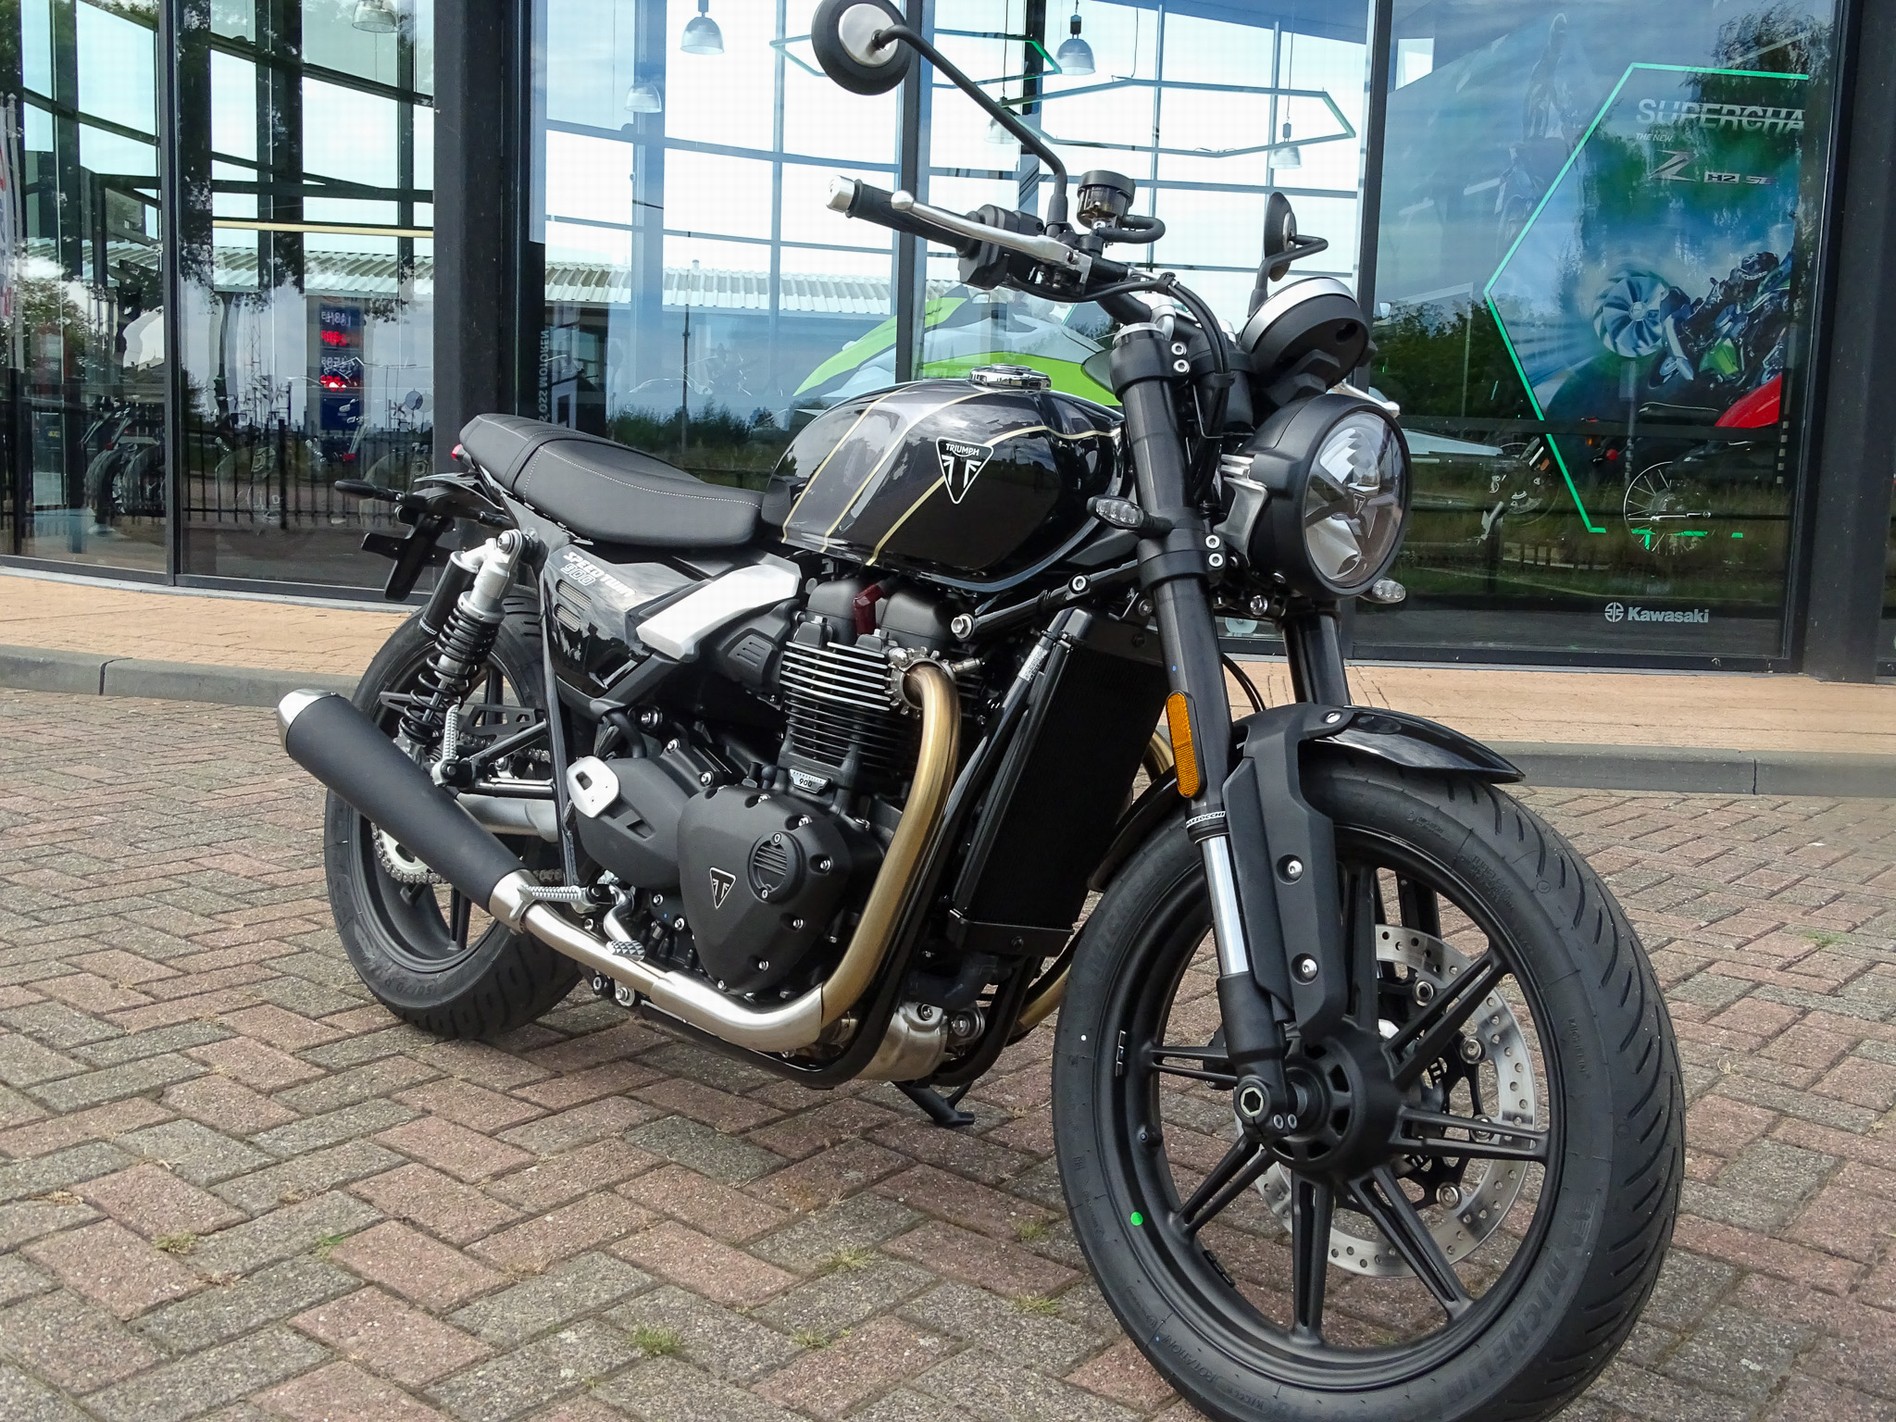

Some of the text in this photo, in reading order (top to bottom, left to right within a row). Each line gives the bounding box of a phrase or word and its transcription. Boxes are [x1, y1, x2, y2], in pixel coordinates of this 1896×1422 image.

[1706, 173, 1738, 183] H2
[945, 442, 980, 456] TRIUMPH
[560, 563, 596, 586] 900
[563, 551, 636, 598] SPEED TWIN
[1627, 606, 1710, 623] Kawasaki
[799, 777, 813, 788] 900
[1158, 1333, 1218, 1385] ROTATION
